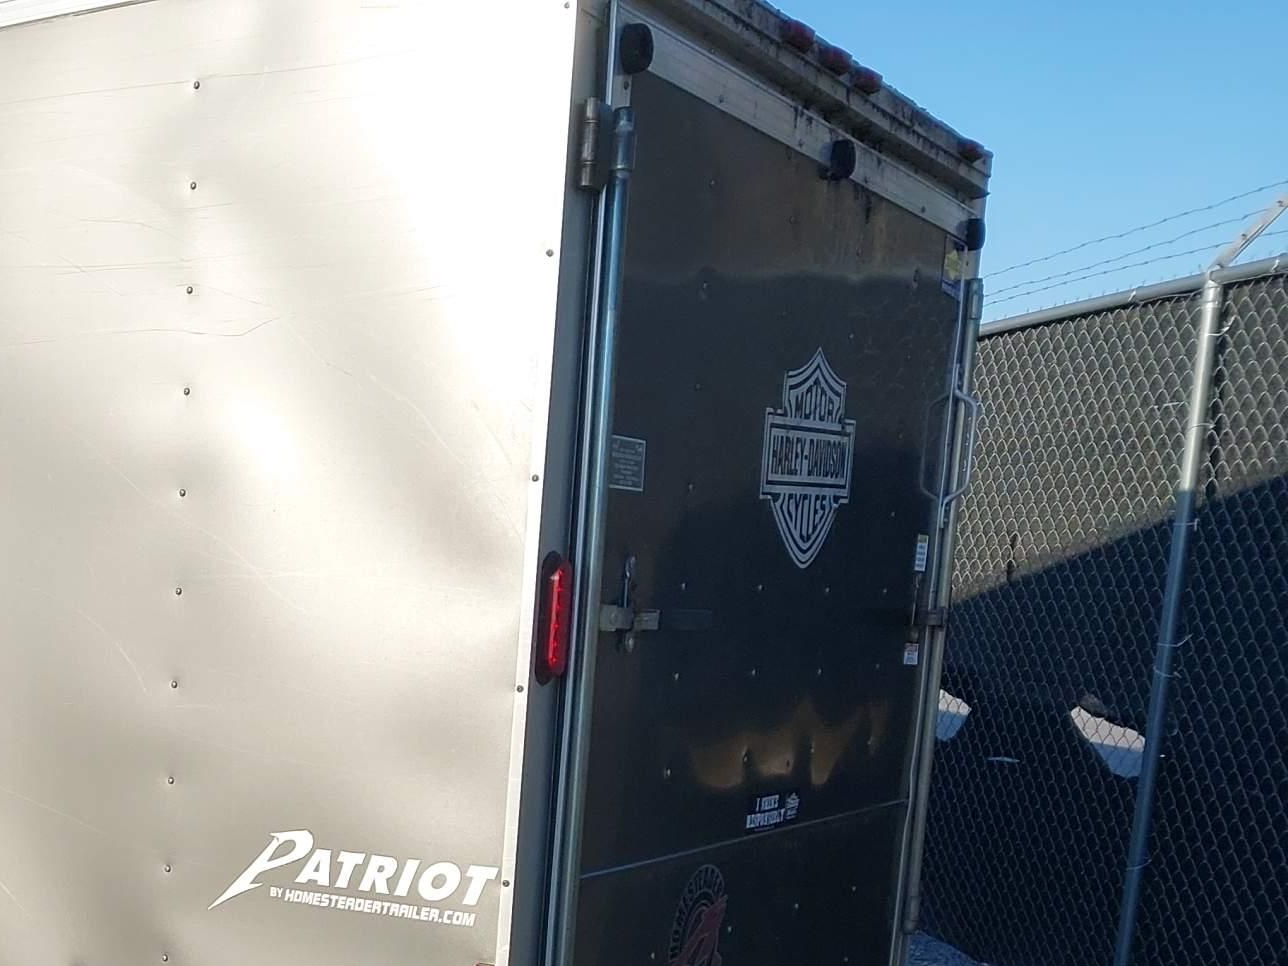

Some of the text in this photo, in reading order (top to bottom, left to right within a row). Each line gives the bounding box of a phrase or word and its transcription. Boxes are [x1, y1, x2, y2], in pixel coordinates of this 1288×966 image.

[793, 379, 838, 423] MOTOR
[771, 435, 848, 478] HARLEY-DAVIDSON
[787, 493, 827, 543] CYCLES
[208, 829, 499, 911] PATRIOT
[269, 886, 476, 927] BY HOMESTEADERTRAILER.COM
